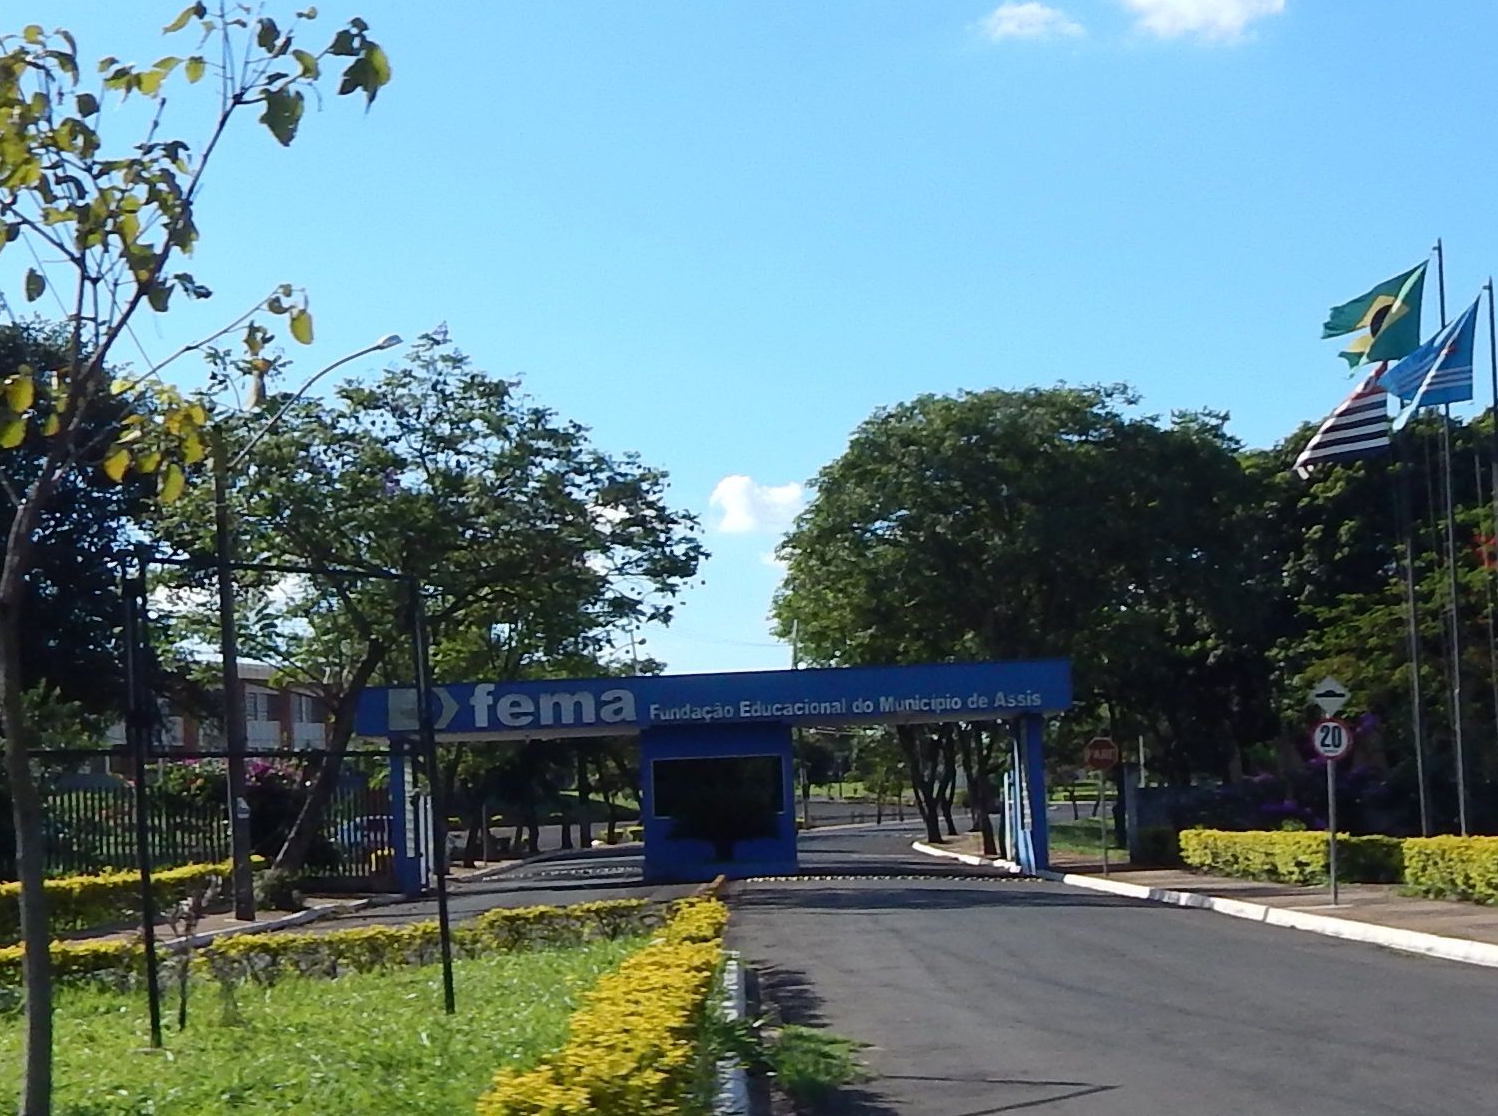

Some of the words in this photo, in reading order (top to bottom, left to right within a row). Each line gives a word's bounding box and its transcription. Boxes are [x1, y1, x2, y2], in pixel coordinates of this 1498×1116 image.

[469, 683, 637, 728] fema
[739, 698, 846, 717] Educacional
[852, 698, 874, 713] do
[967, 692, 988, 708] de
[994, 690, 1041, 707] Assis
[1320, 725, 1342, 748] 20
